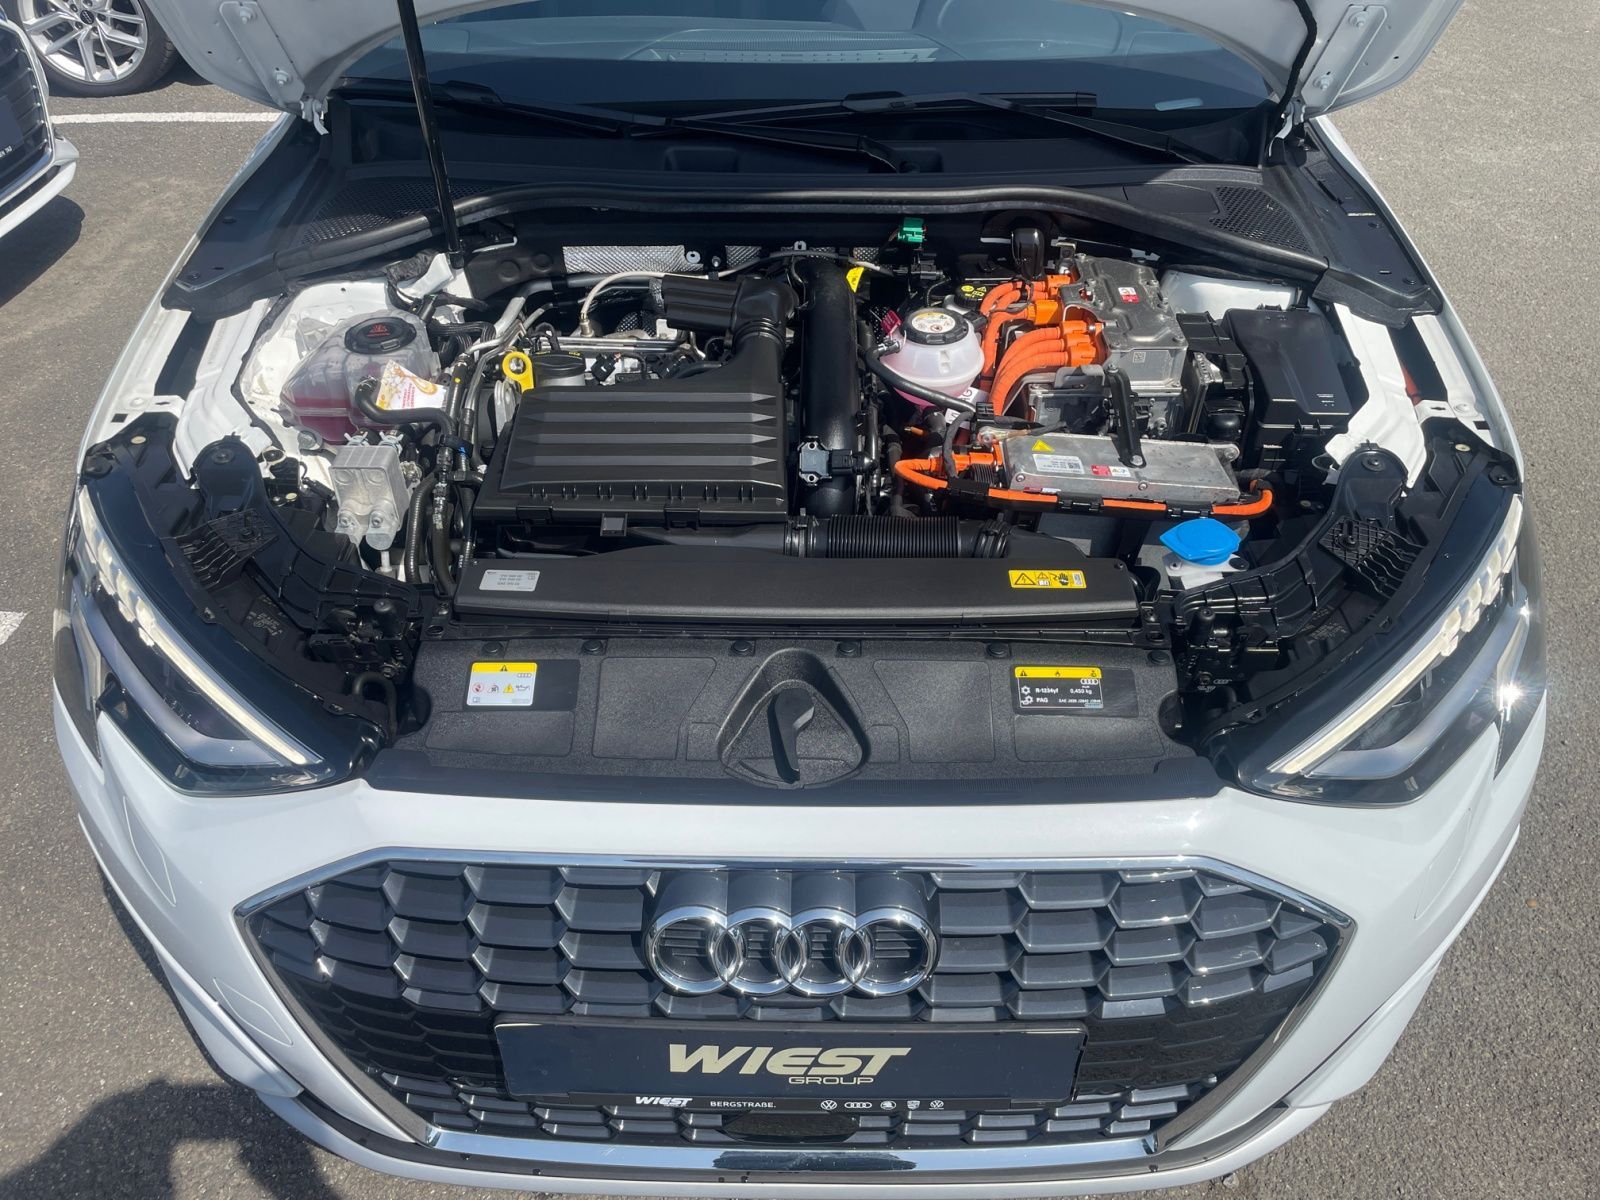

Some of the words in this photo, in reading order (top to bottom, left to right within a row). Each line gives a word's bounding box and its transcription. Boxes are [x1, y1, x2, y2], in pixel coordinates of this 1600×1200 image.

[669, 1043, 912, 1076] WIEST
[788, 1076, 874, 1085] GROUP
[635, 1096, 693, 1106] WIEST
